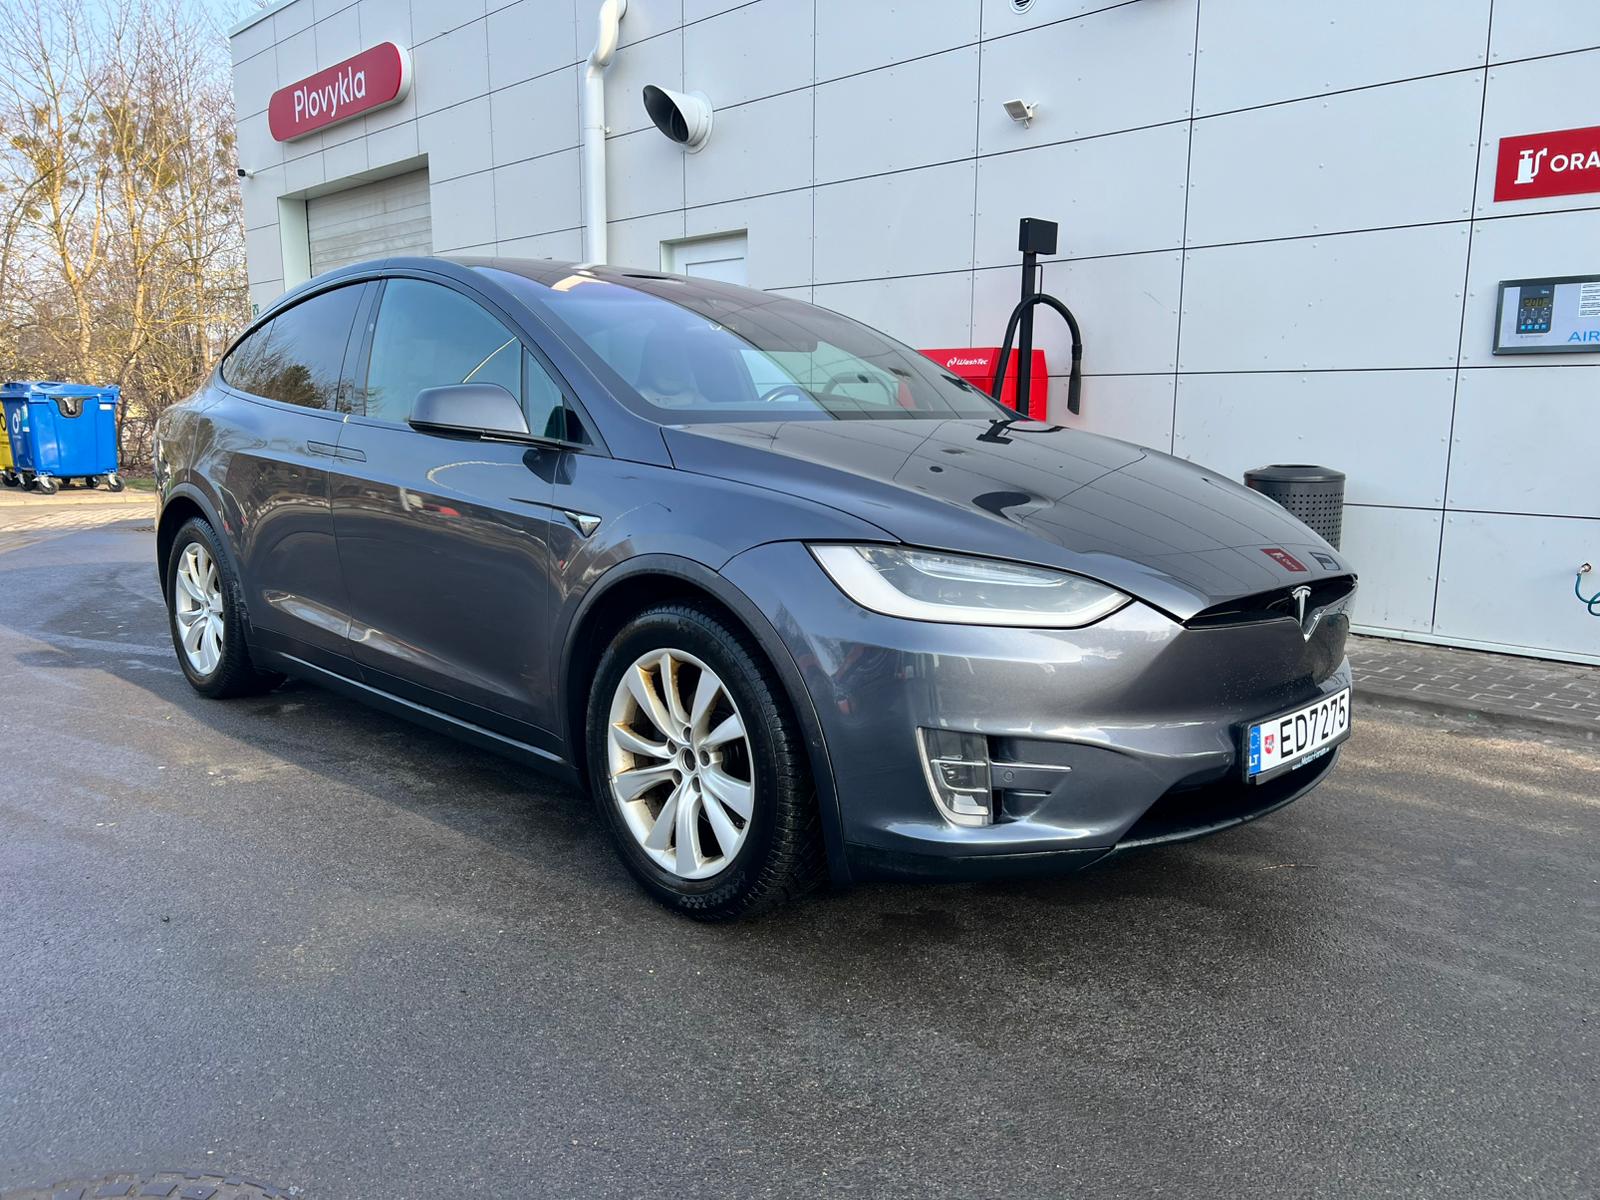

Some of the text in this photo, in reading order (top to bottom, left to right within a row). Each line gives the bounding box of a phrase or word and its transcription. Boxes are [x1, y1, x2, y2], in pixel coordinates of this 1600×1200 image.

[293, 66, 366, 123] Plovykla
[1549, 150, 1600, 172] ORA
[1567, 330, 1600, 343] AIR
[956, 358, 989, 366] WashTec
[1280, 694, 1346, 759] ED7275
